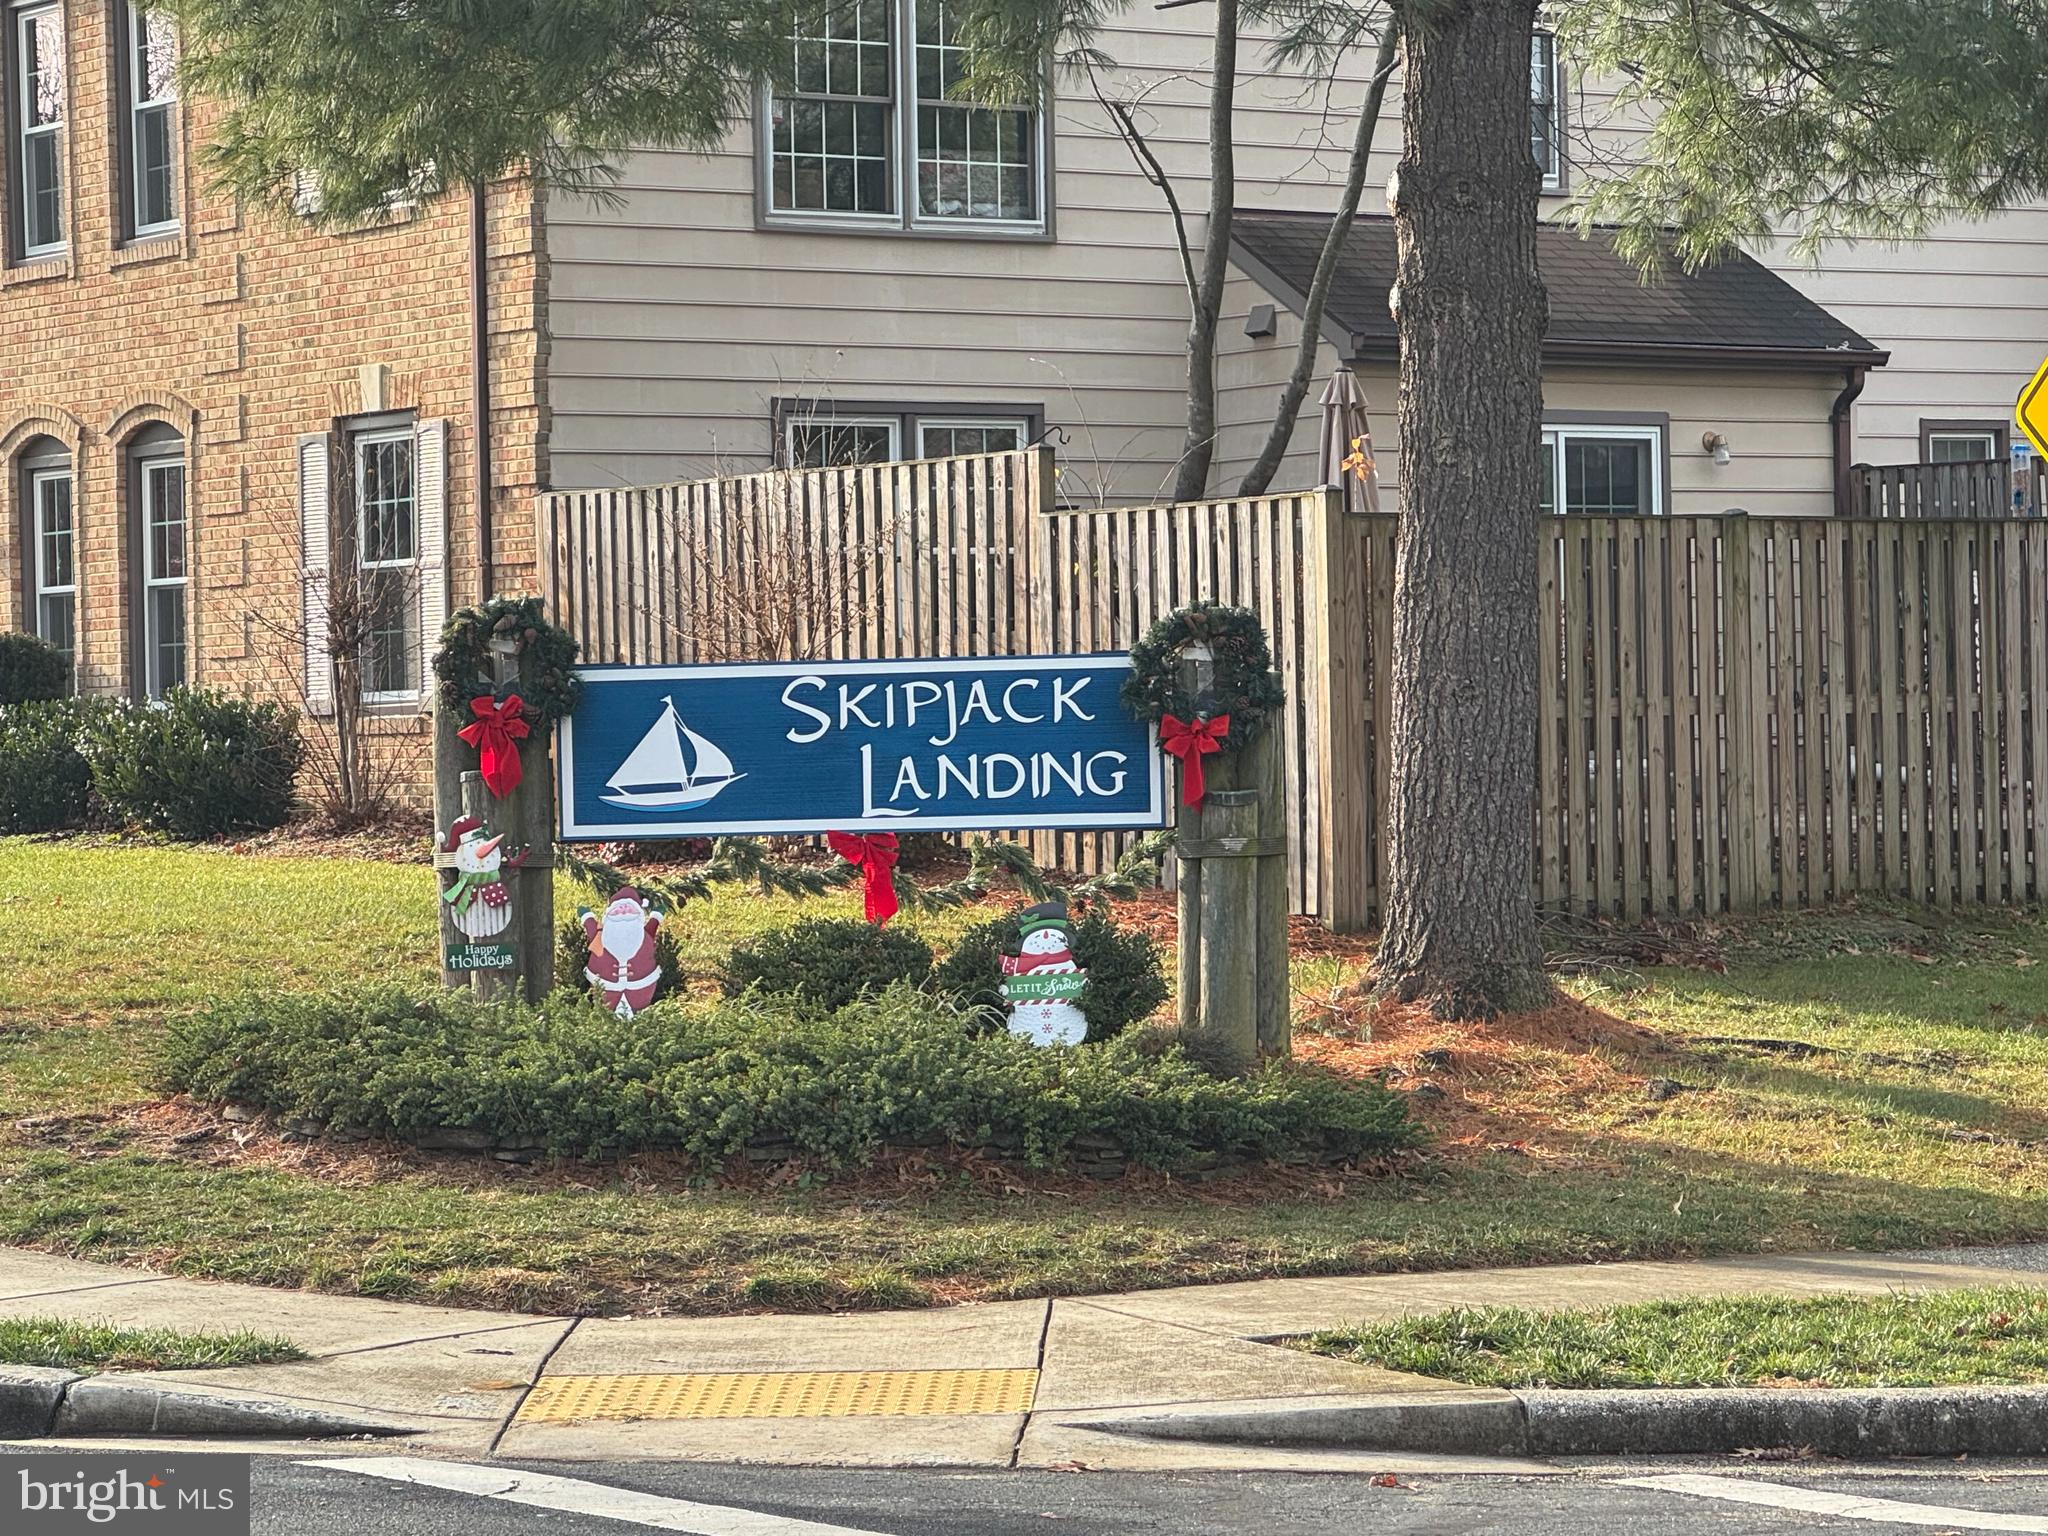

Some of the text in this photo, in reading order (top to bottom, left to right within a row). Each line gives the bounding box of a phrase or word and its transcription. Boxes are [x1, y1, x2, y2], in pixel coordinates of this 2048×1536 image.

[781, 675, 1096, 748] SKIPJACK
[861, 743, 1128, 818] LANDING
[465, 945, 500, 956] Happy
[449, 954, 513, 969] Holidays
[1010, 977, 1081, 996] LET IT Snow
